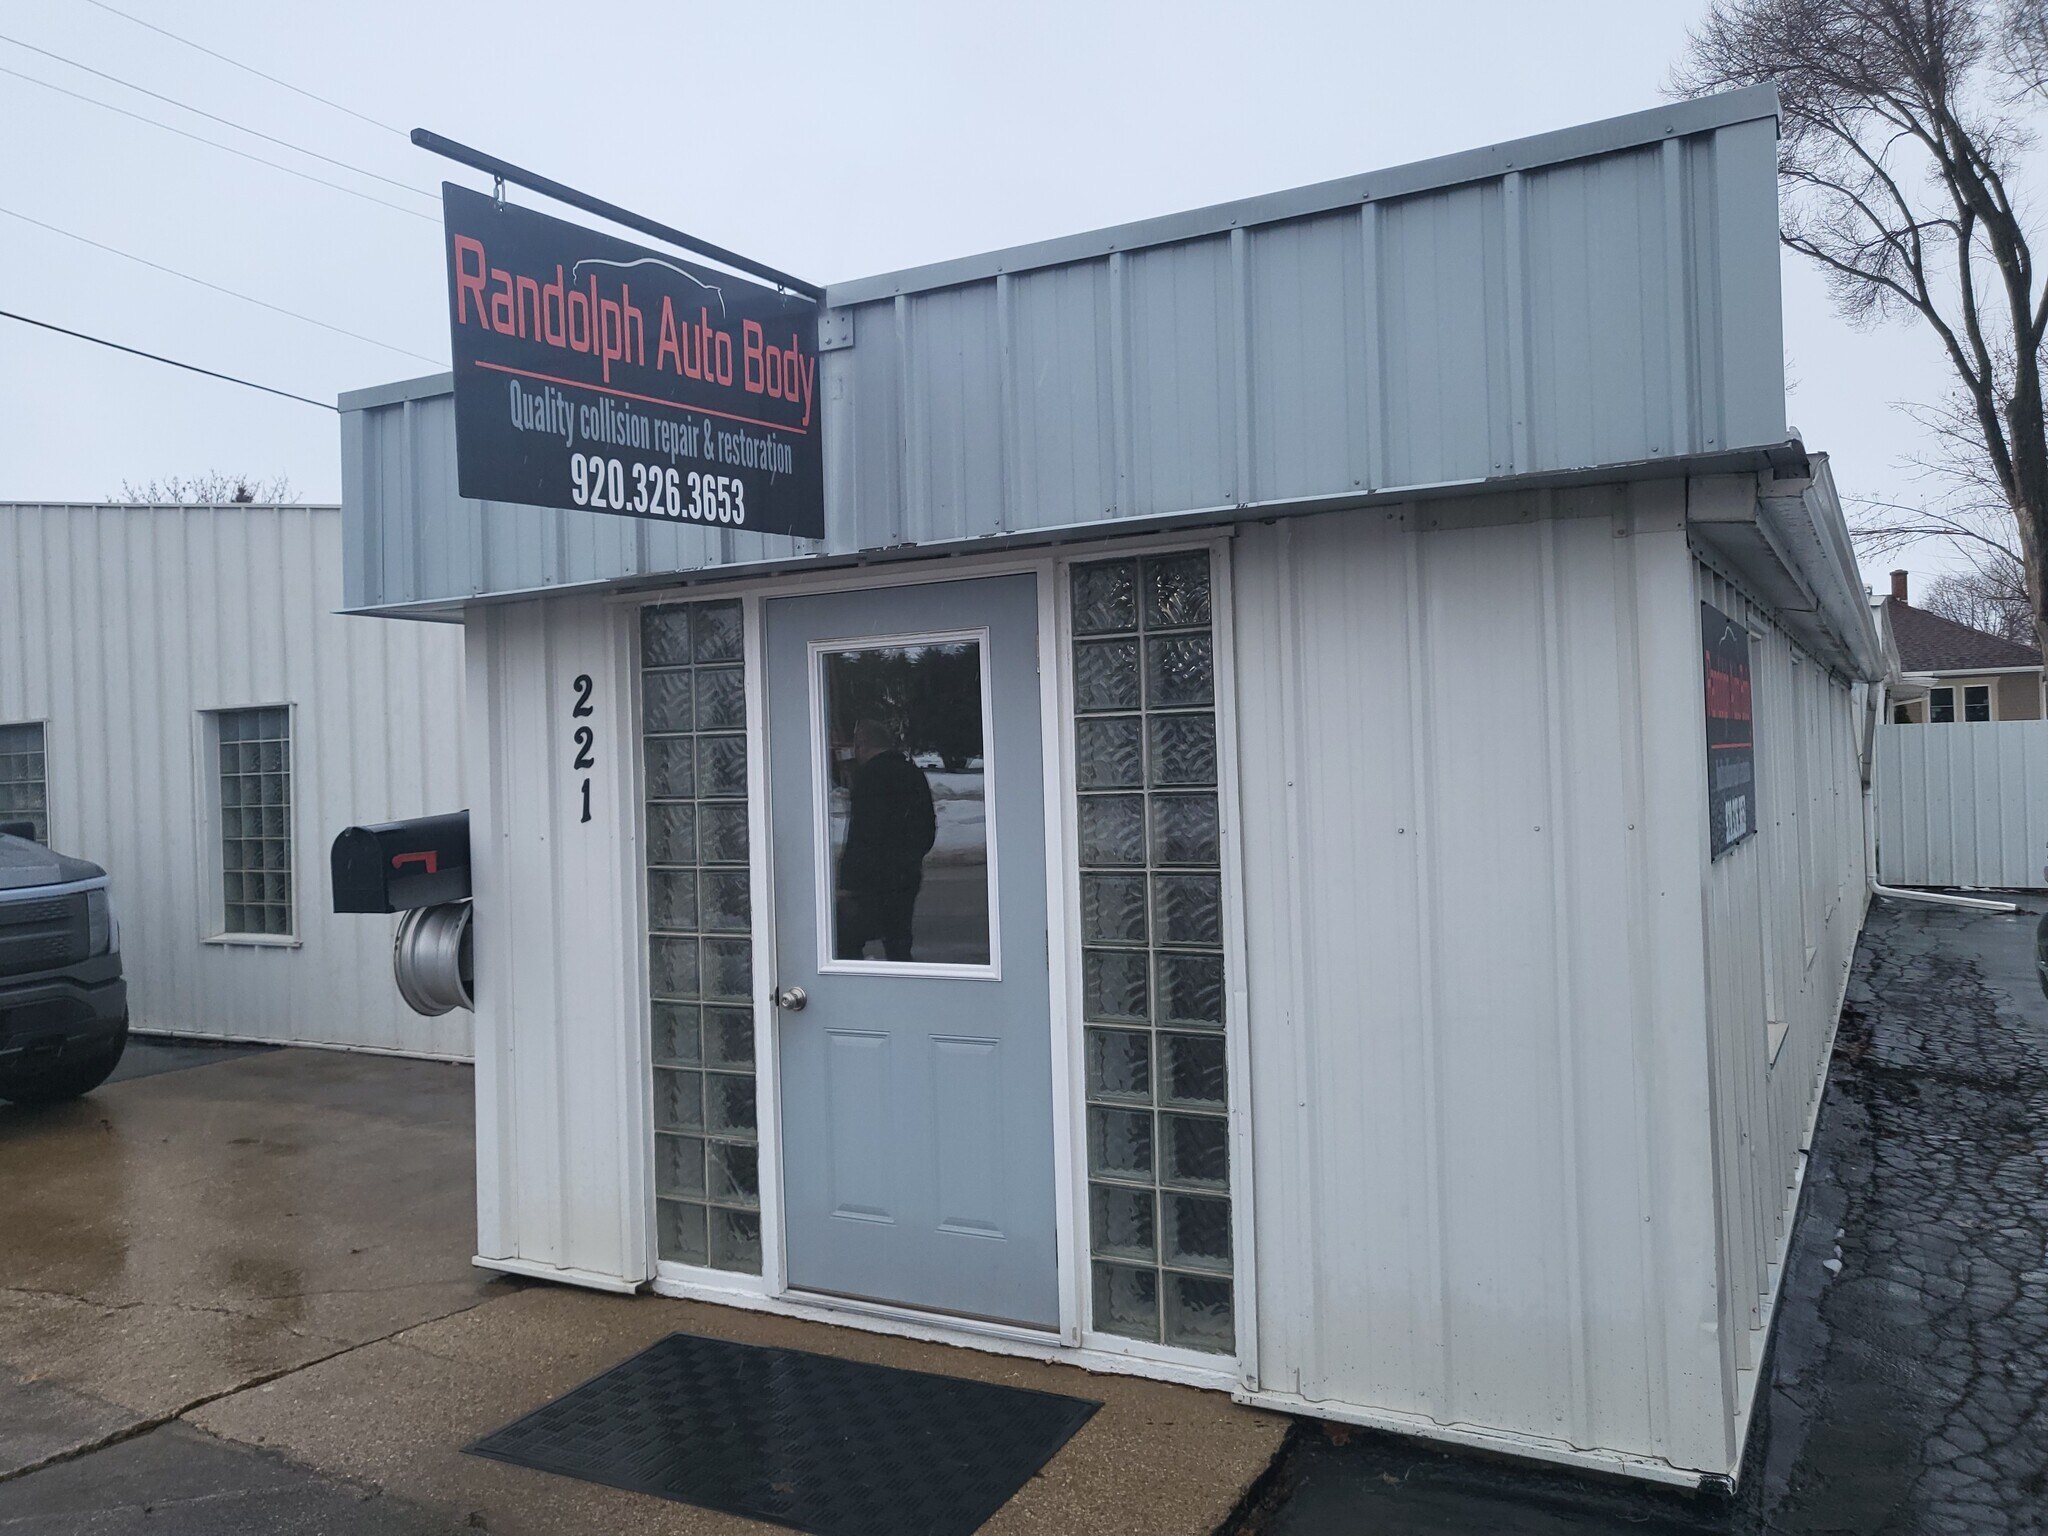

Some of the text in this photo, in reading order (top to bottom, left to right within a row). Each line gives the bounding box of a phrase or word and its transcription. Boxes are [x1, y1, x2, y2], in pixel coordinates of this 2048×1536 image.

[454, 234, 815, 426] Randolph Auto Body
[510, 380, 793, 475] Quality collision repair & restoration
[571, 453, 745, 525] 920.326.3653
[572, 674, 594, 824] 221
